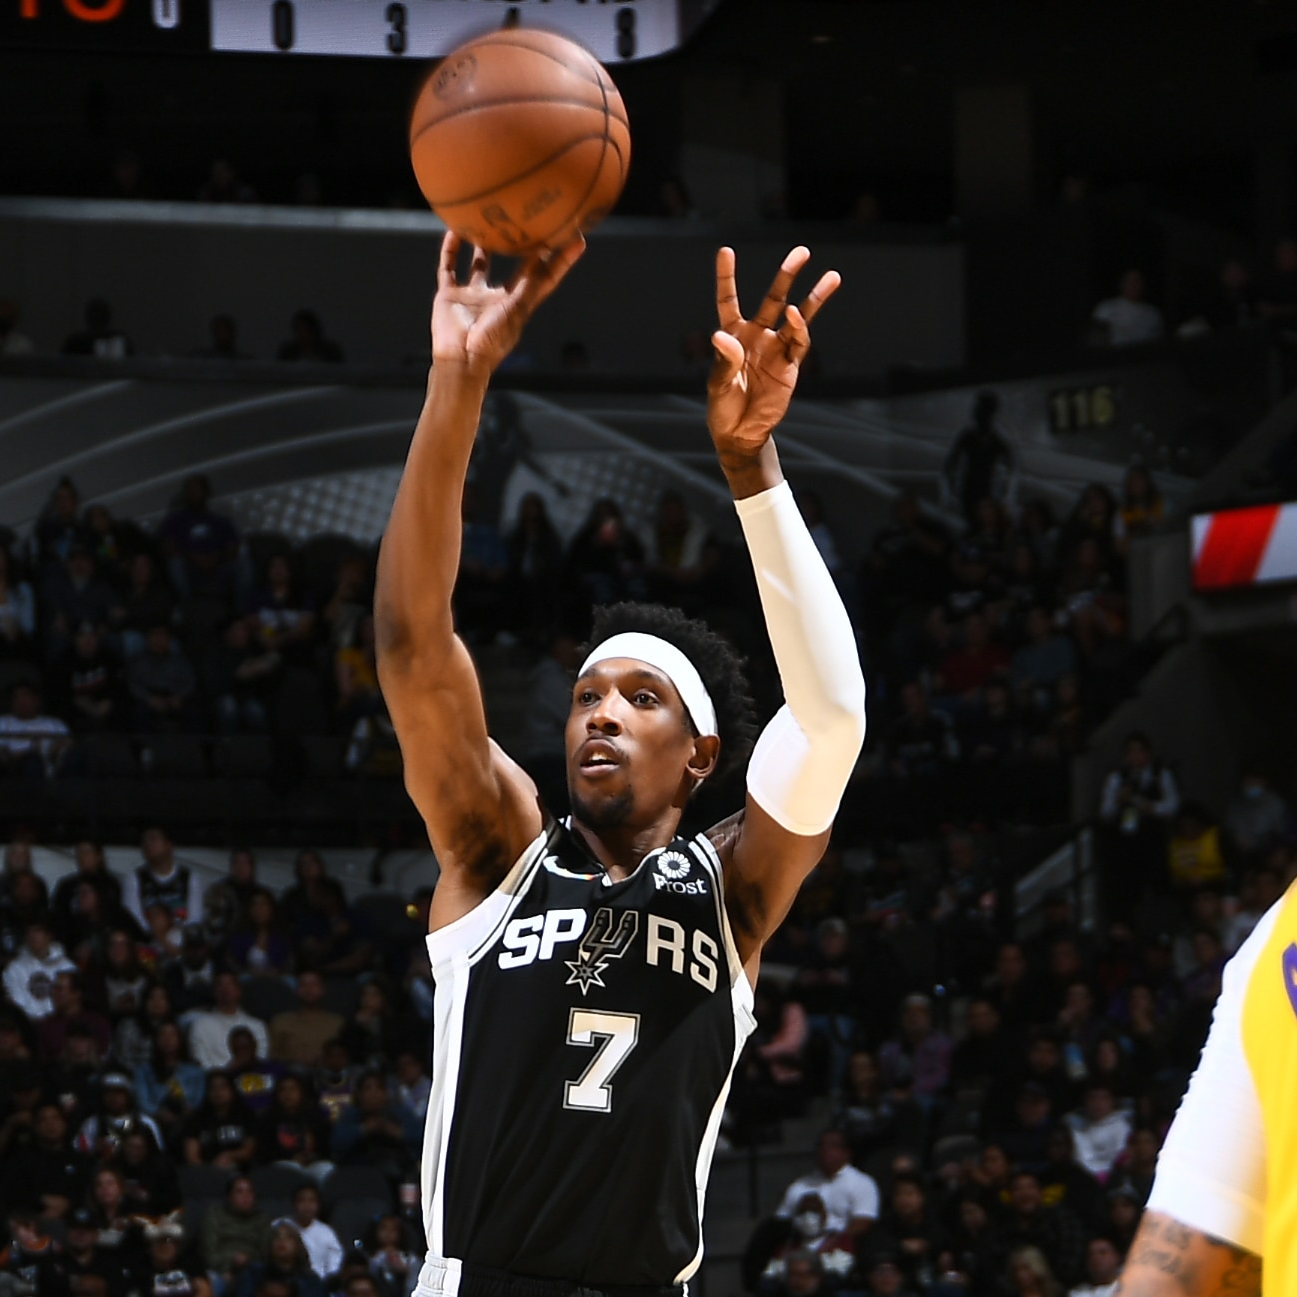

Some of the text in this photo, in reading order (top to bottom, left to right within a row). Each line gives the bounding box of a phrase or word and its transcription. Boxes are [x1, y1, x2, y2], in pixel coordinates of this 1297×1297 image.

[388, 3, 406, 53] 3
[617, 8, 635, 59] 8
[1050, 386, 1115, 430] 116
[653, 872, 708, 895] Frost
[498, 906, 720, 995] SPURS
[562, 1006, 642, 1113] 7
